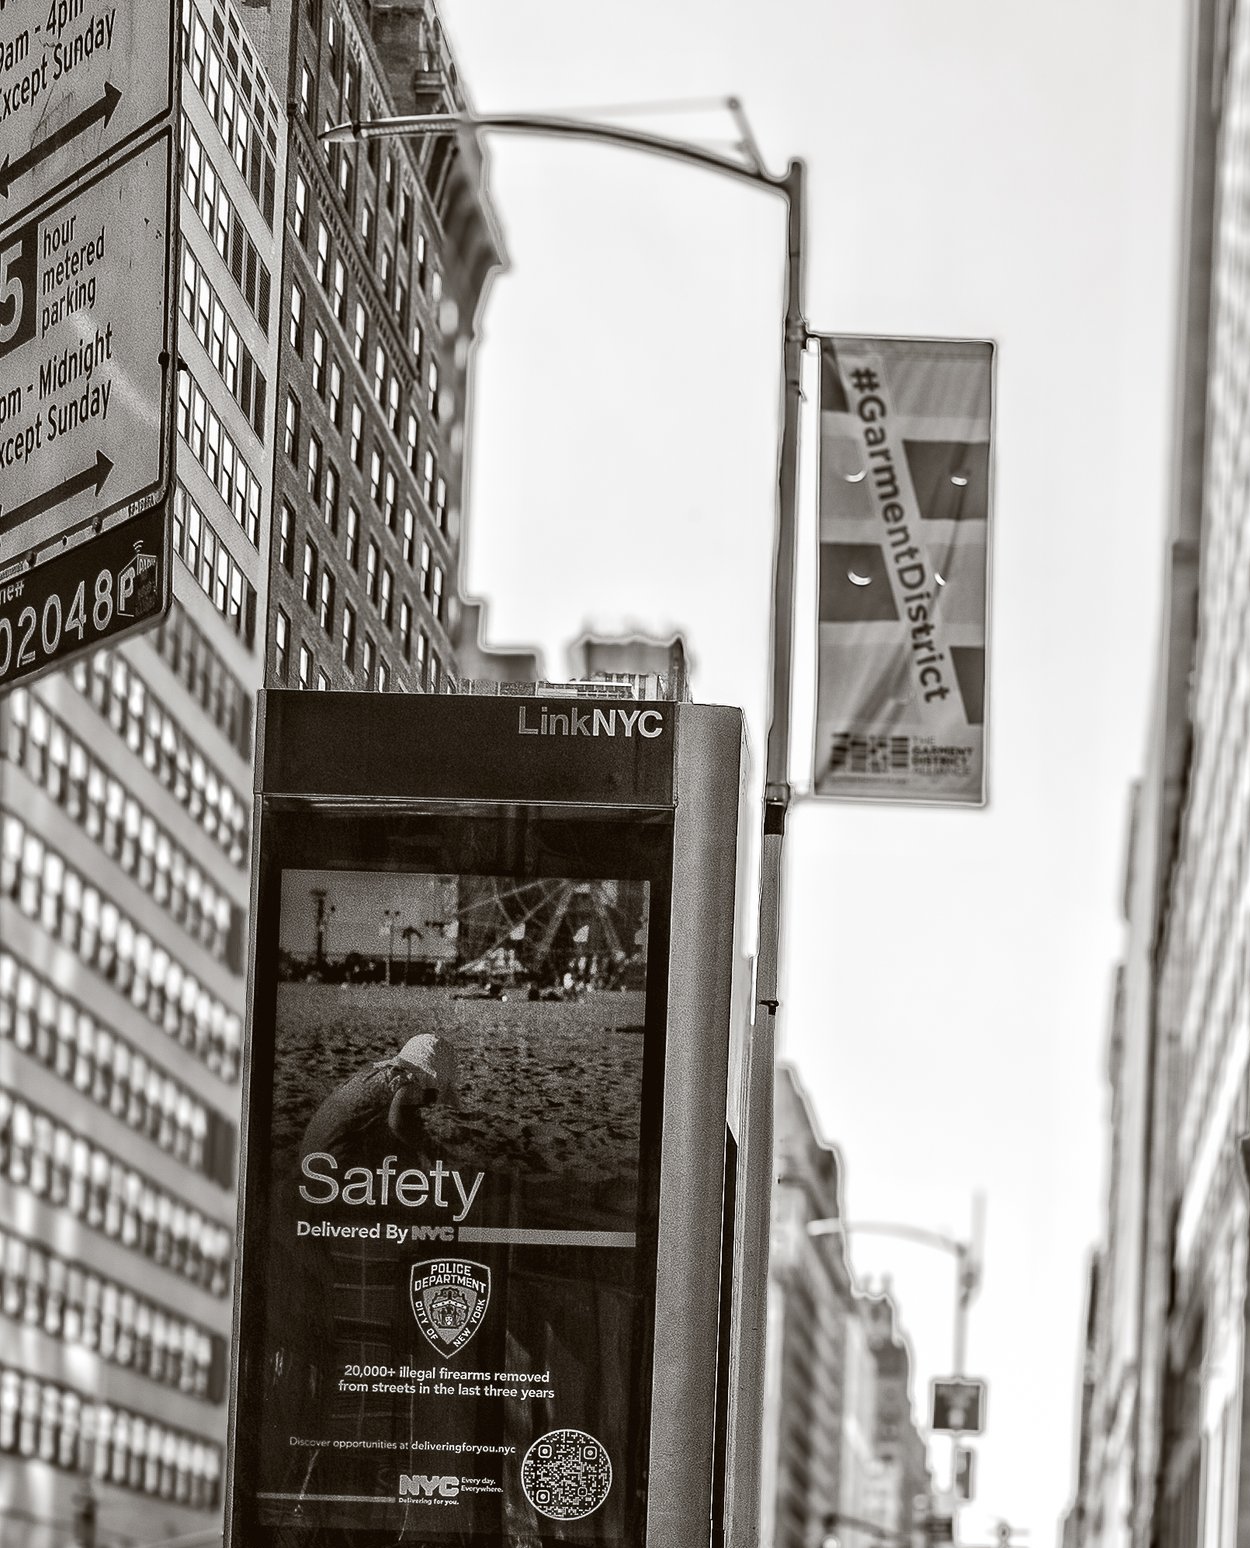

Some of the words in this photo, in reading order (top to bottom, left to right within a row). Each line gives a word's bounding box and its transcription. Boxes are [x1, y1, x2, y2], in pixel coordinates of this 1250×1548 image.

[0, 53, 48, 121] xcept
[53, 8, 116, 80] Sunday
[43, 215, 77, 259] hour
[43, 225, 105, 296] metered
[42, 276, 96, 339] parking
[39, 322, 113, 400] Midnight
[47, 379, 112, 441] Sunday
[850, 367, 951, 704] #GarmentDistrict
[517, 706, 663, 739] LinkNYC
[298, 1152, 485, 1222] Safety
[296, 1220, 381, 1239] Delivered
[386, 1223, 409, 1244] By
[411, 1225, 455, 1242] NYC
[414, 1274, 487, 1293] DEPARTMENT
[430, 1263, 472, 1276] POLICE
[415, 1301, 429, 1324] CITY
[426, 1328, 439, 1340] OF
[453, 1327, 471, 1348] NEW
[470, 1299, 486, 1324] YORK
[338, 1379, 369, 1392] from
[372, 1382, 416, 1394] streets
[419, 1383, 430, 1394] in
[433, 1383, 455, 1395] the
[458, 1383, 481, 1396] last
[484, 1384, 518, 1397] three
[520, 1389, 555, 1401] years
[344, 1364, 396, 1378] 20,000+
[399, 1366, 436, 1381] illegal
[439, 1367, 491, 1381] firearms
[494, 1371, 550, 1383] removed
[289, 1436, 331, 1447] Discover
[333, 1440, 398, 1450] opportunities
[411, 1441, 516, 1455] deliveringforyou.nyc
[399, 1474, 460, 1497] NYC
[461, 1477, 481, 1486] Every
[461, 1485, 504, 1493] Everywhere.
[398, 1497, 432, 1506] Delivering
